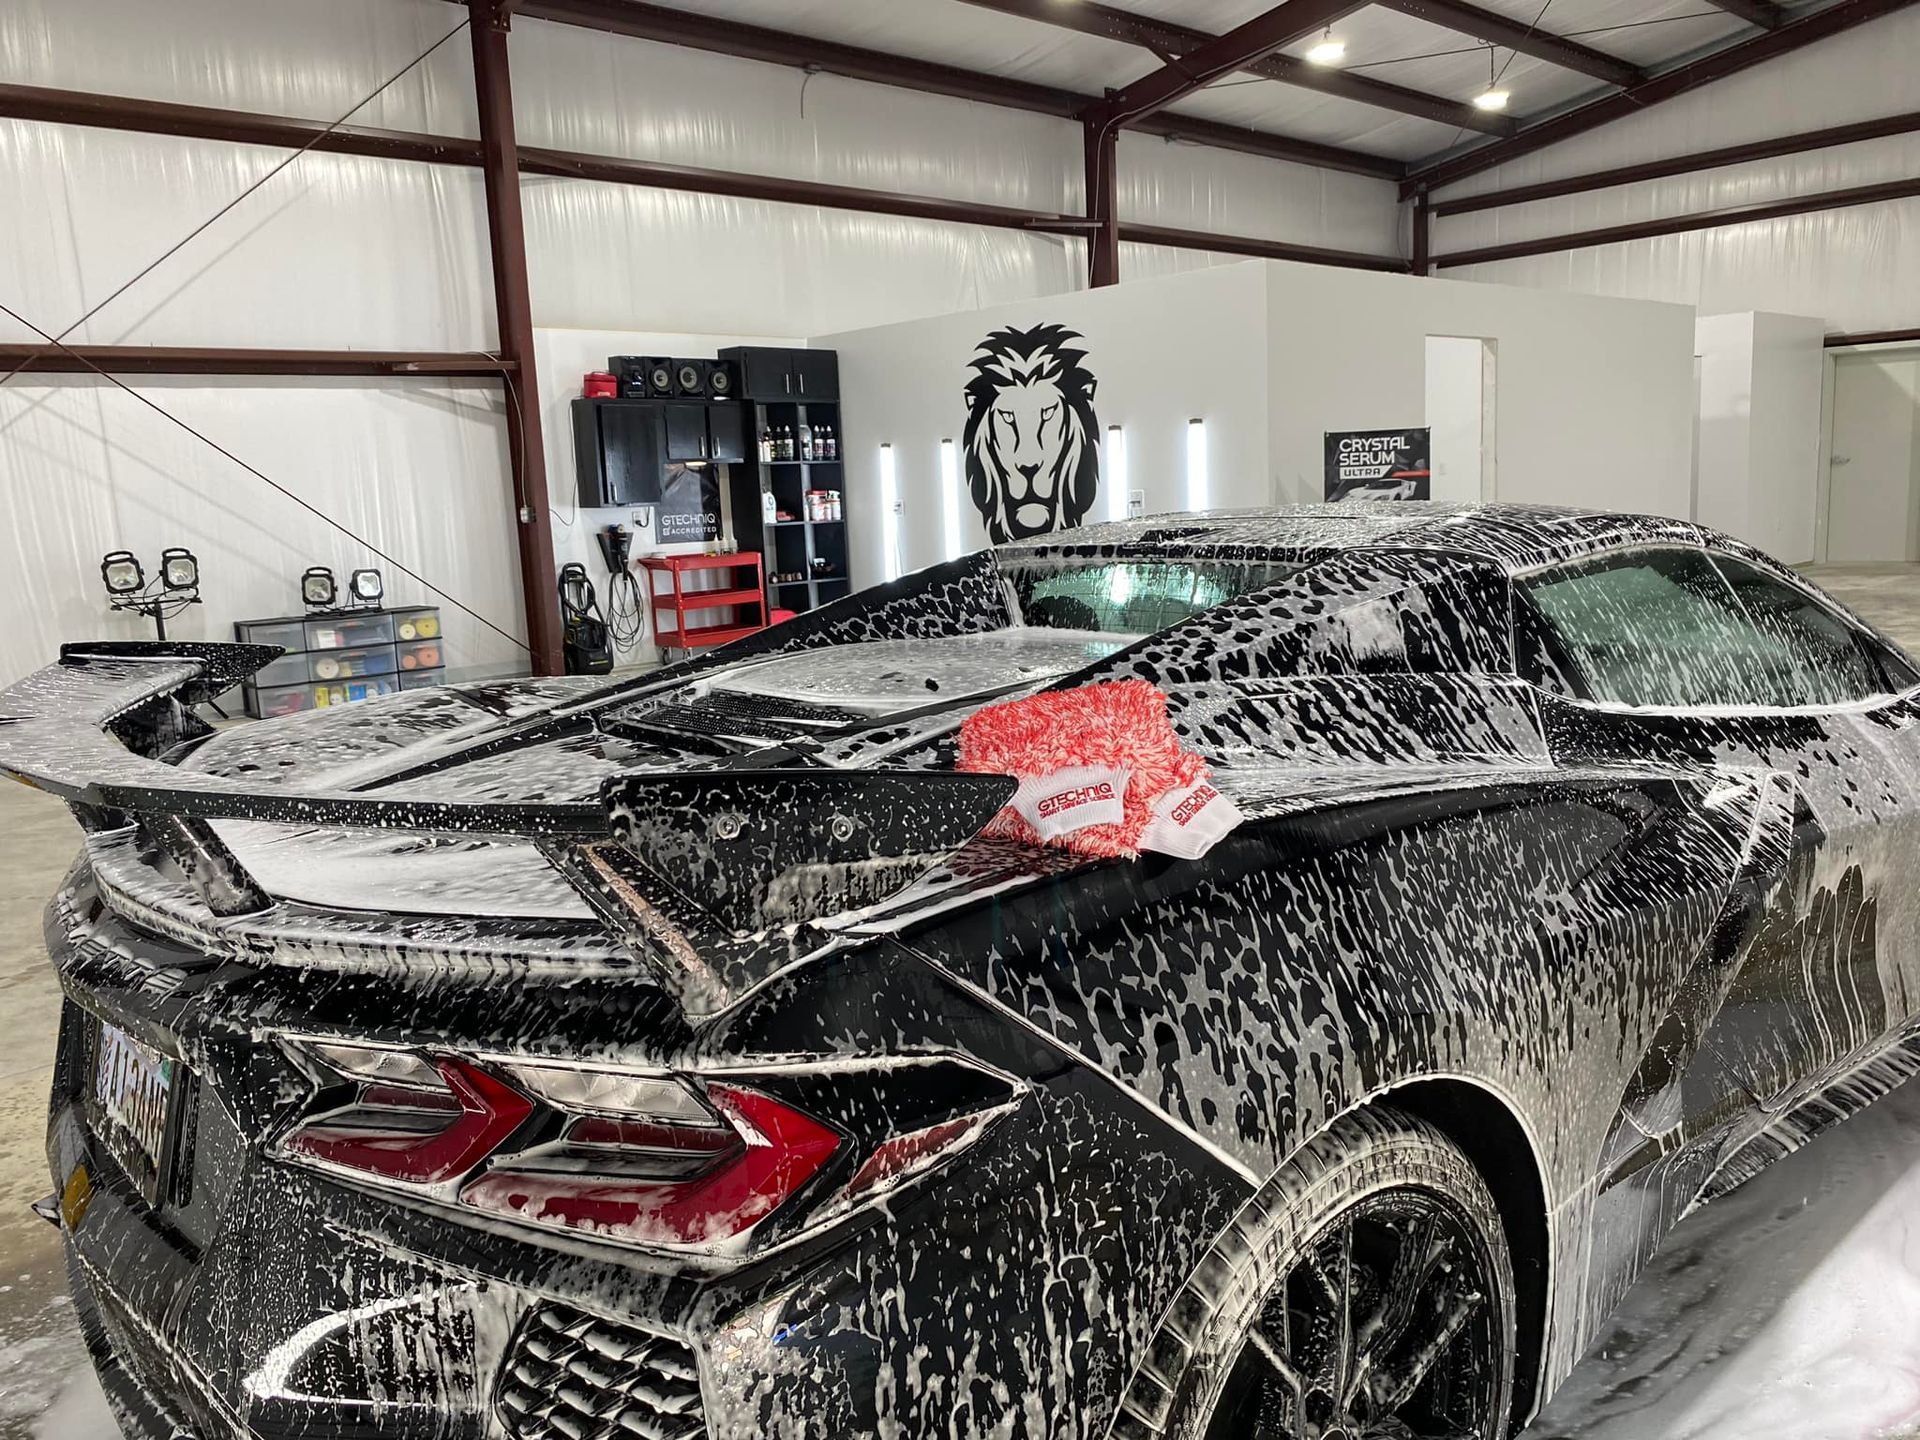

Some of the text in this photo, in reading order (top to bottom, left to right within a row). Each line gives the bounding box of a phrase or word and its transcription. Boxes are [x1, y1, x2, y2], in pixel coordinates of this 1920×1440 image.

[1339, 436, 1411, 452] CRYSTAL
[1339, 450, 1395, 466] SERUM
[1343, 467, 1381, 477] ULTRA
[661, 513, 716, 526] GTECHNIQ
[671, 526, 717, 535] ACCREDITED
[1037, 782, 1113, 812] GTECHNIQ
